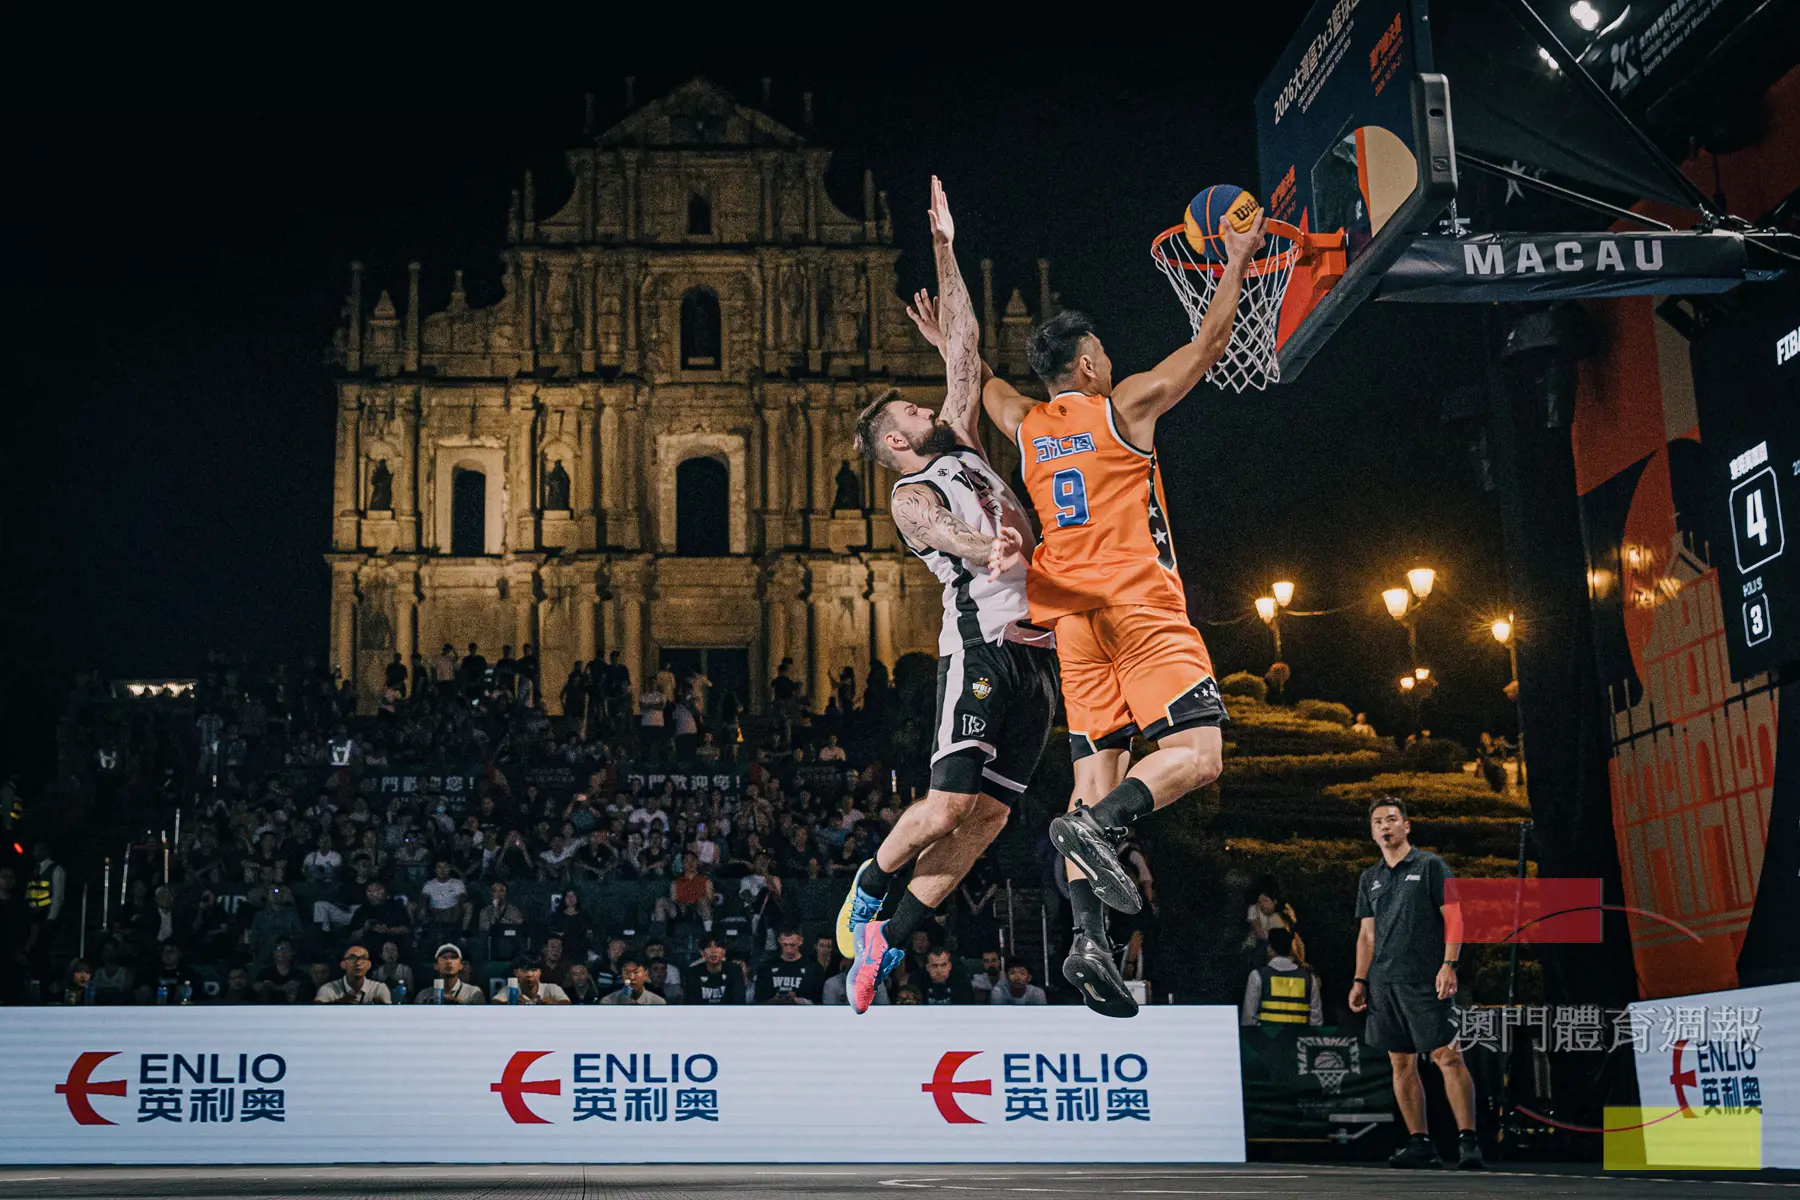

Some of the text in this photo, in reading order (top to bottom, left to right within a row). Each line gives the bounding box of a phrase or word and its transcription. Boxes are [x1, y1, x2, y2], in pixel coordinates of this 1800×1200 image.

[1464, 238, 1663, 275] MACAU
[1776, 326, 1800, 366] FIB
[1052, 467, 1090, 527] 9
[1747, 489, 1768, 547] 4
[1750, 604, 1763, 635] 3
[772, 976, 802, 988] WOLF
[139, 1053, 287, 1084] ENLIO
[573, 1053, 719, 1083] ENLIO
[1004, 1053, 1148, 1083] ENLIO
[1697, 1039, 1756, 1073] ENLIO
[137, 1087, 286, 1123] 英利奥
[572, 1087, 719, 1122] 英利奥
[1004, 1087, 1151, 1122] 英利奥
